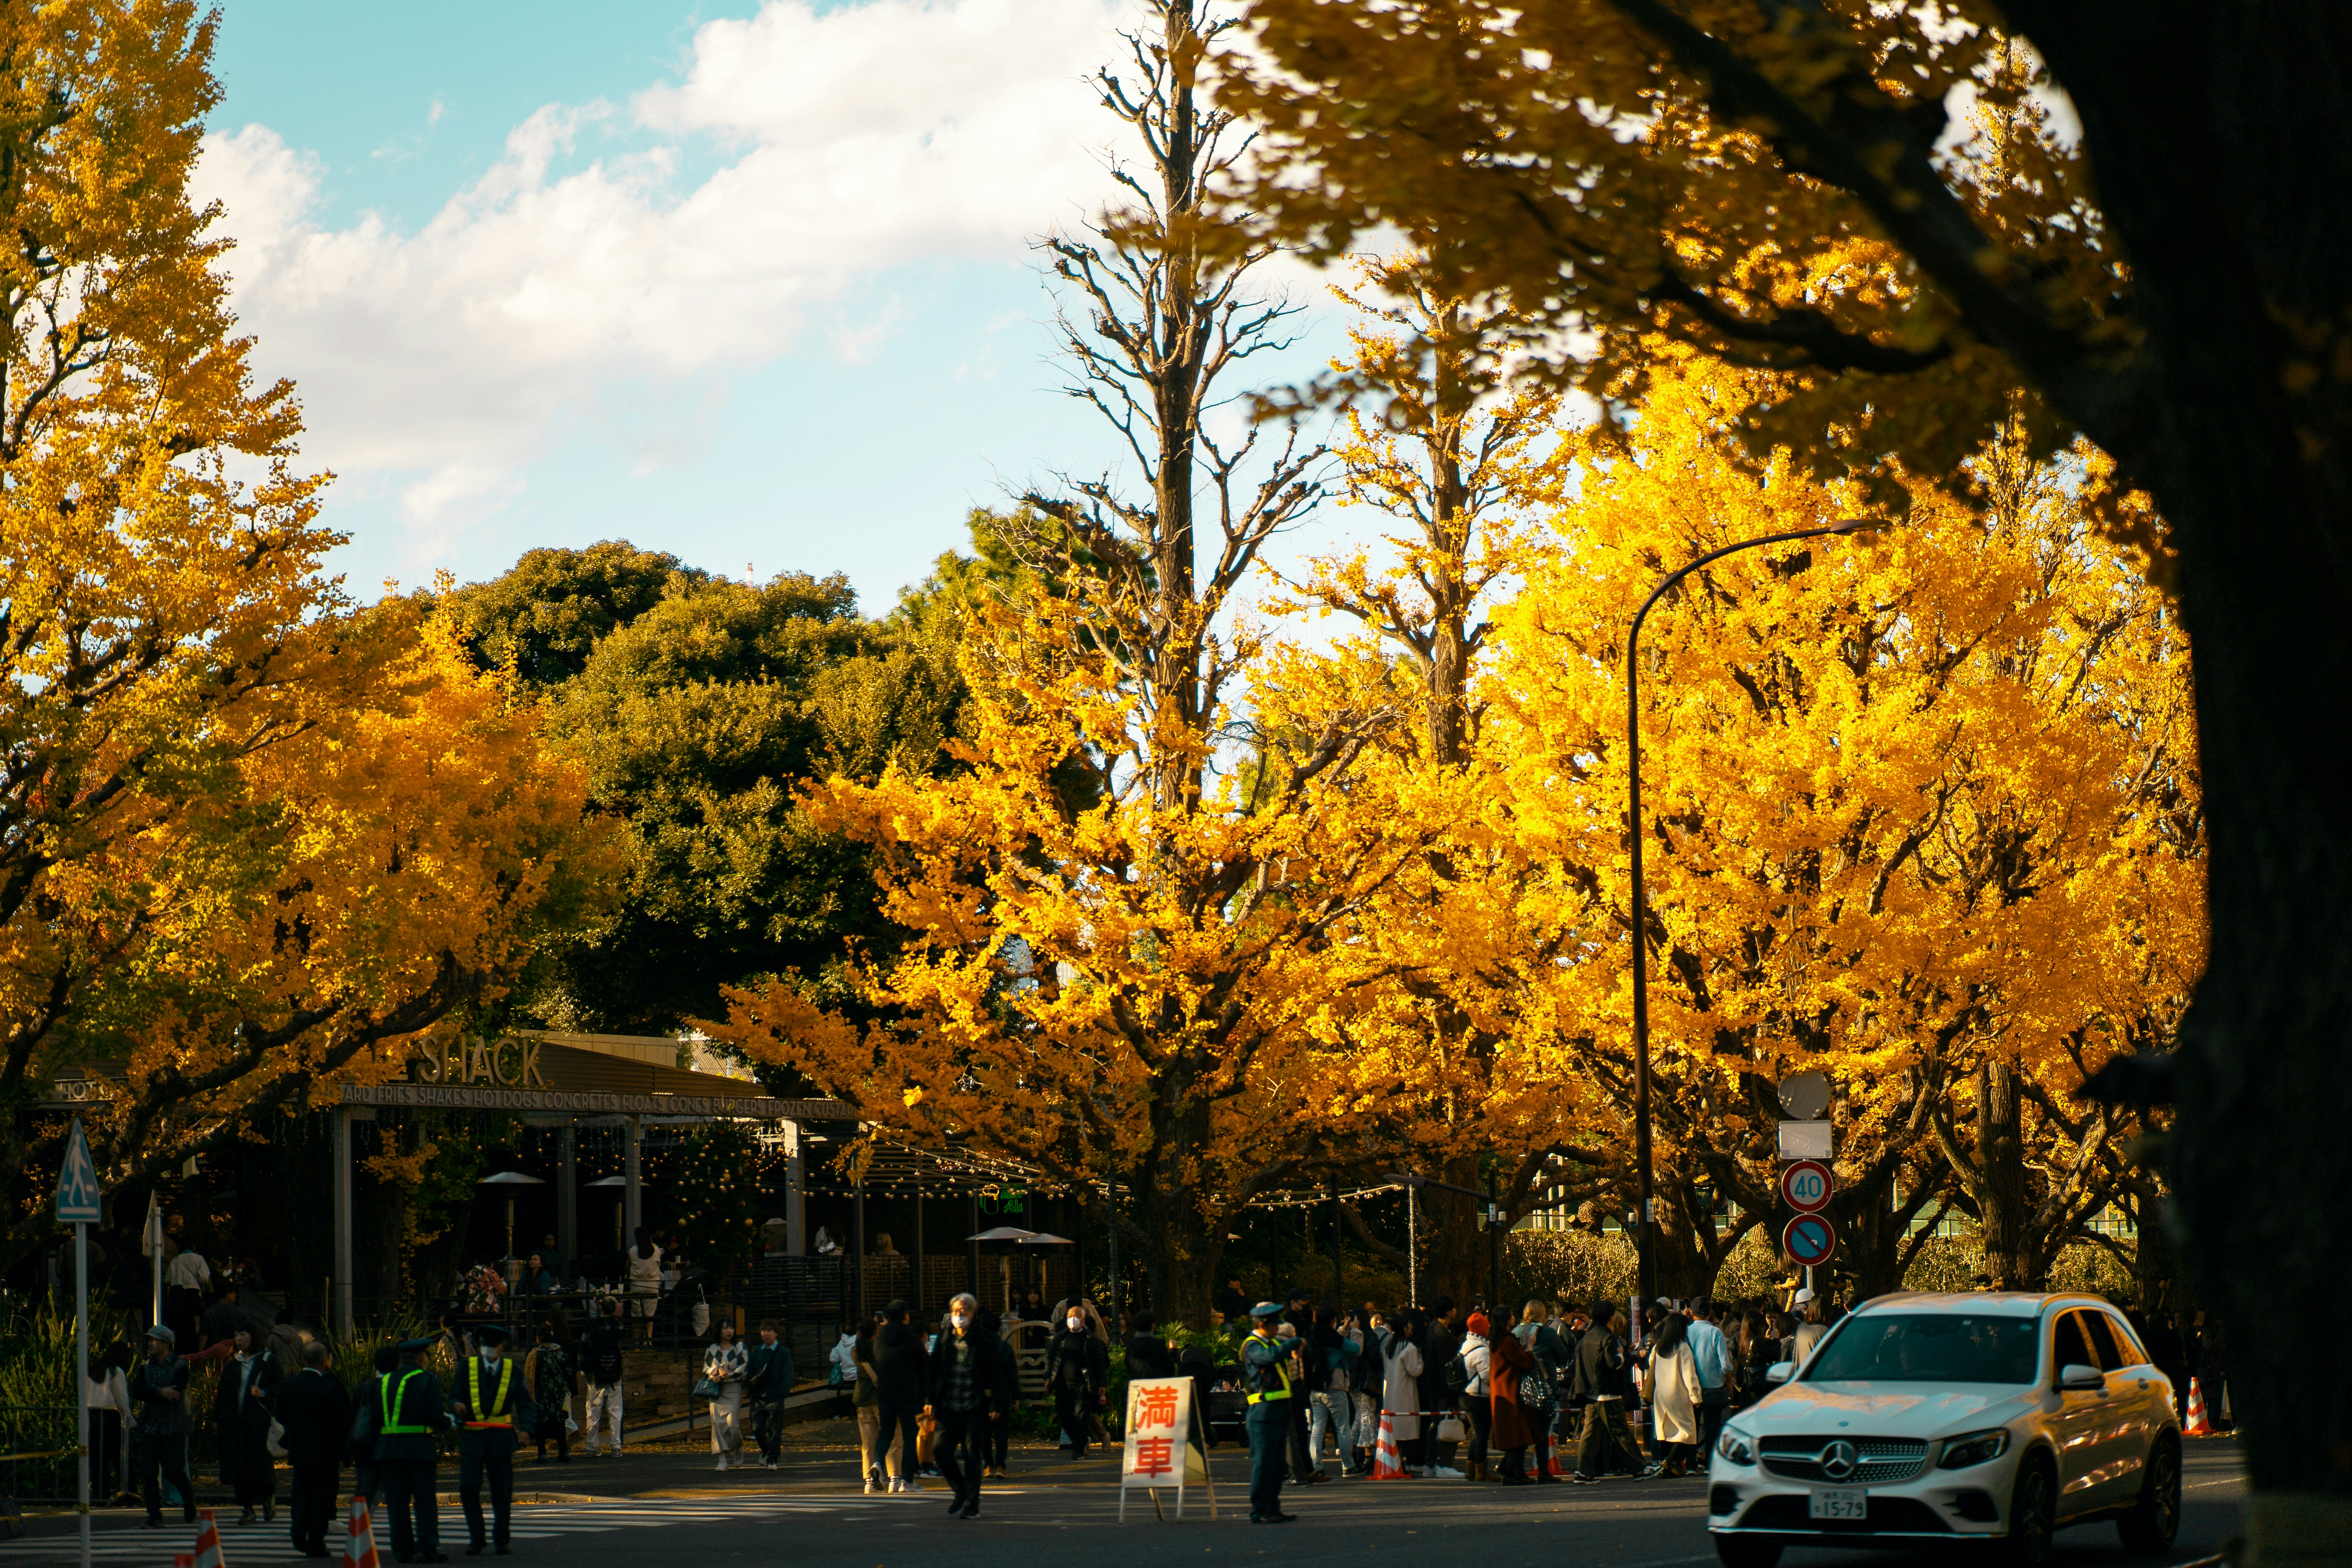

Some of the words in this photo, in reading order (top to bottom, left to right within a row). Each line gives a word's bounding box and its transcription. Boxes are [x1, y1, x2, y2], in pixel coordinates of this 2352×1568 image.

[419, 1034, 544, 1085] SHACK
[377, 1086, 411, 1103] FRIES
[419, 1087, 468, 1105] SHAKES
[474, 1089, 502, 1106] HOT
[503, 1091, 538, 1107] DOGS
[544, 1091, 617, 1110] CONCRETES
[622, 1094, 664, 1112] FLOATS
[670, 1096, 708, 1112] CONES
[768, 1099, 811, 1116] FROZEN
[814, 1100, 857, 1118] CUSTAR
[1794, 1175, 1822, 1198] 40
[1134, 1386, 1178, 1479] 満車
[1824, 1501, 1864, 1517] 15-79
